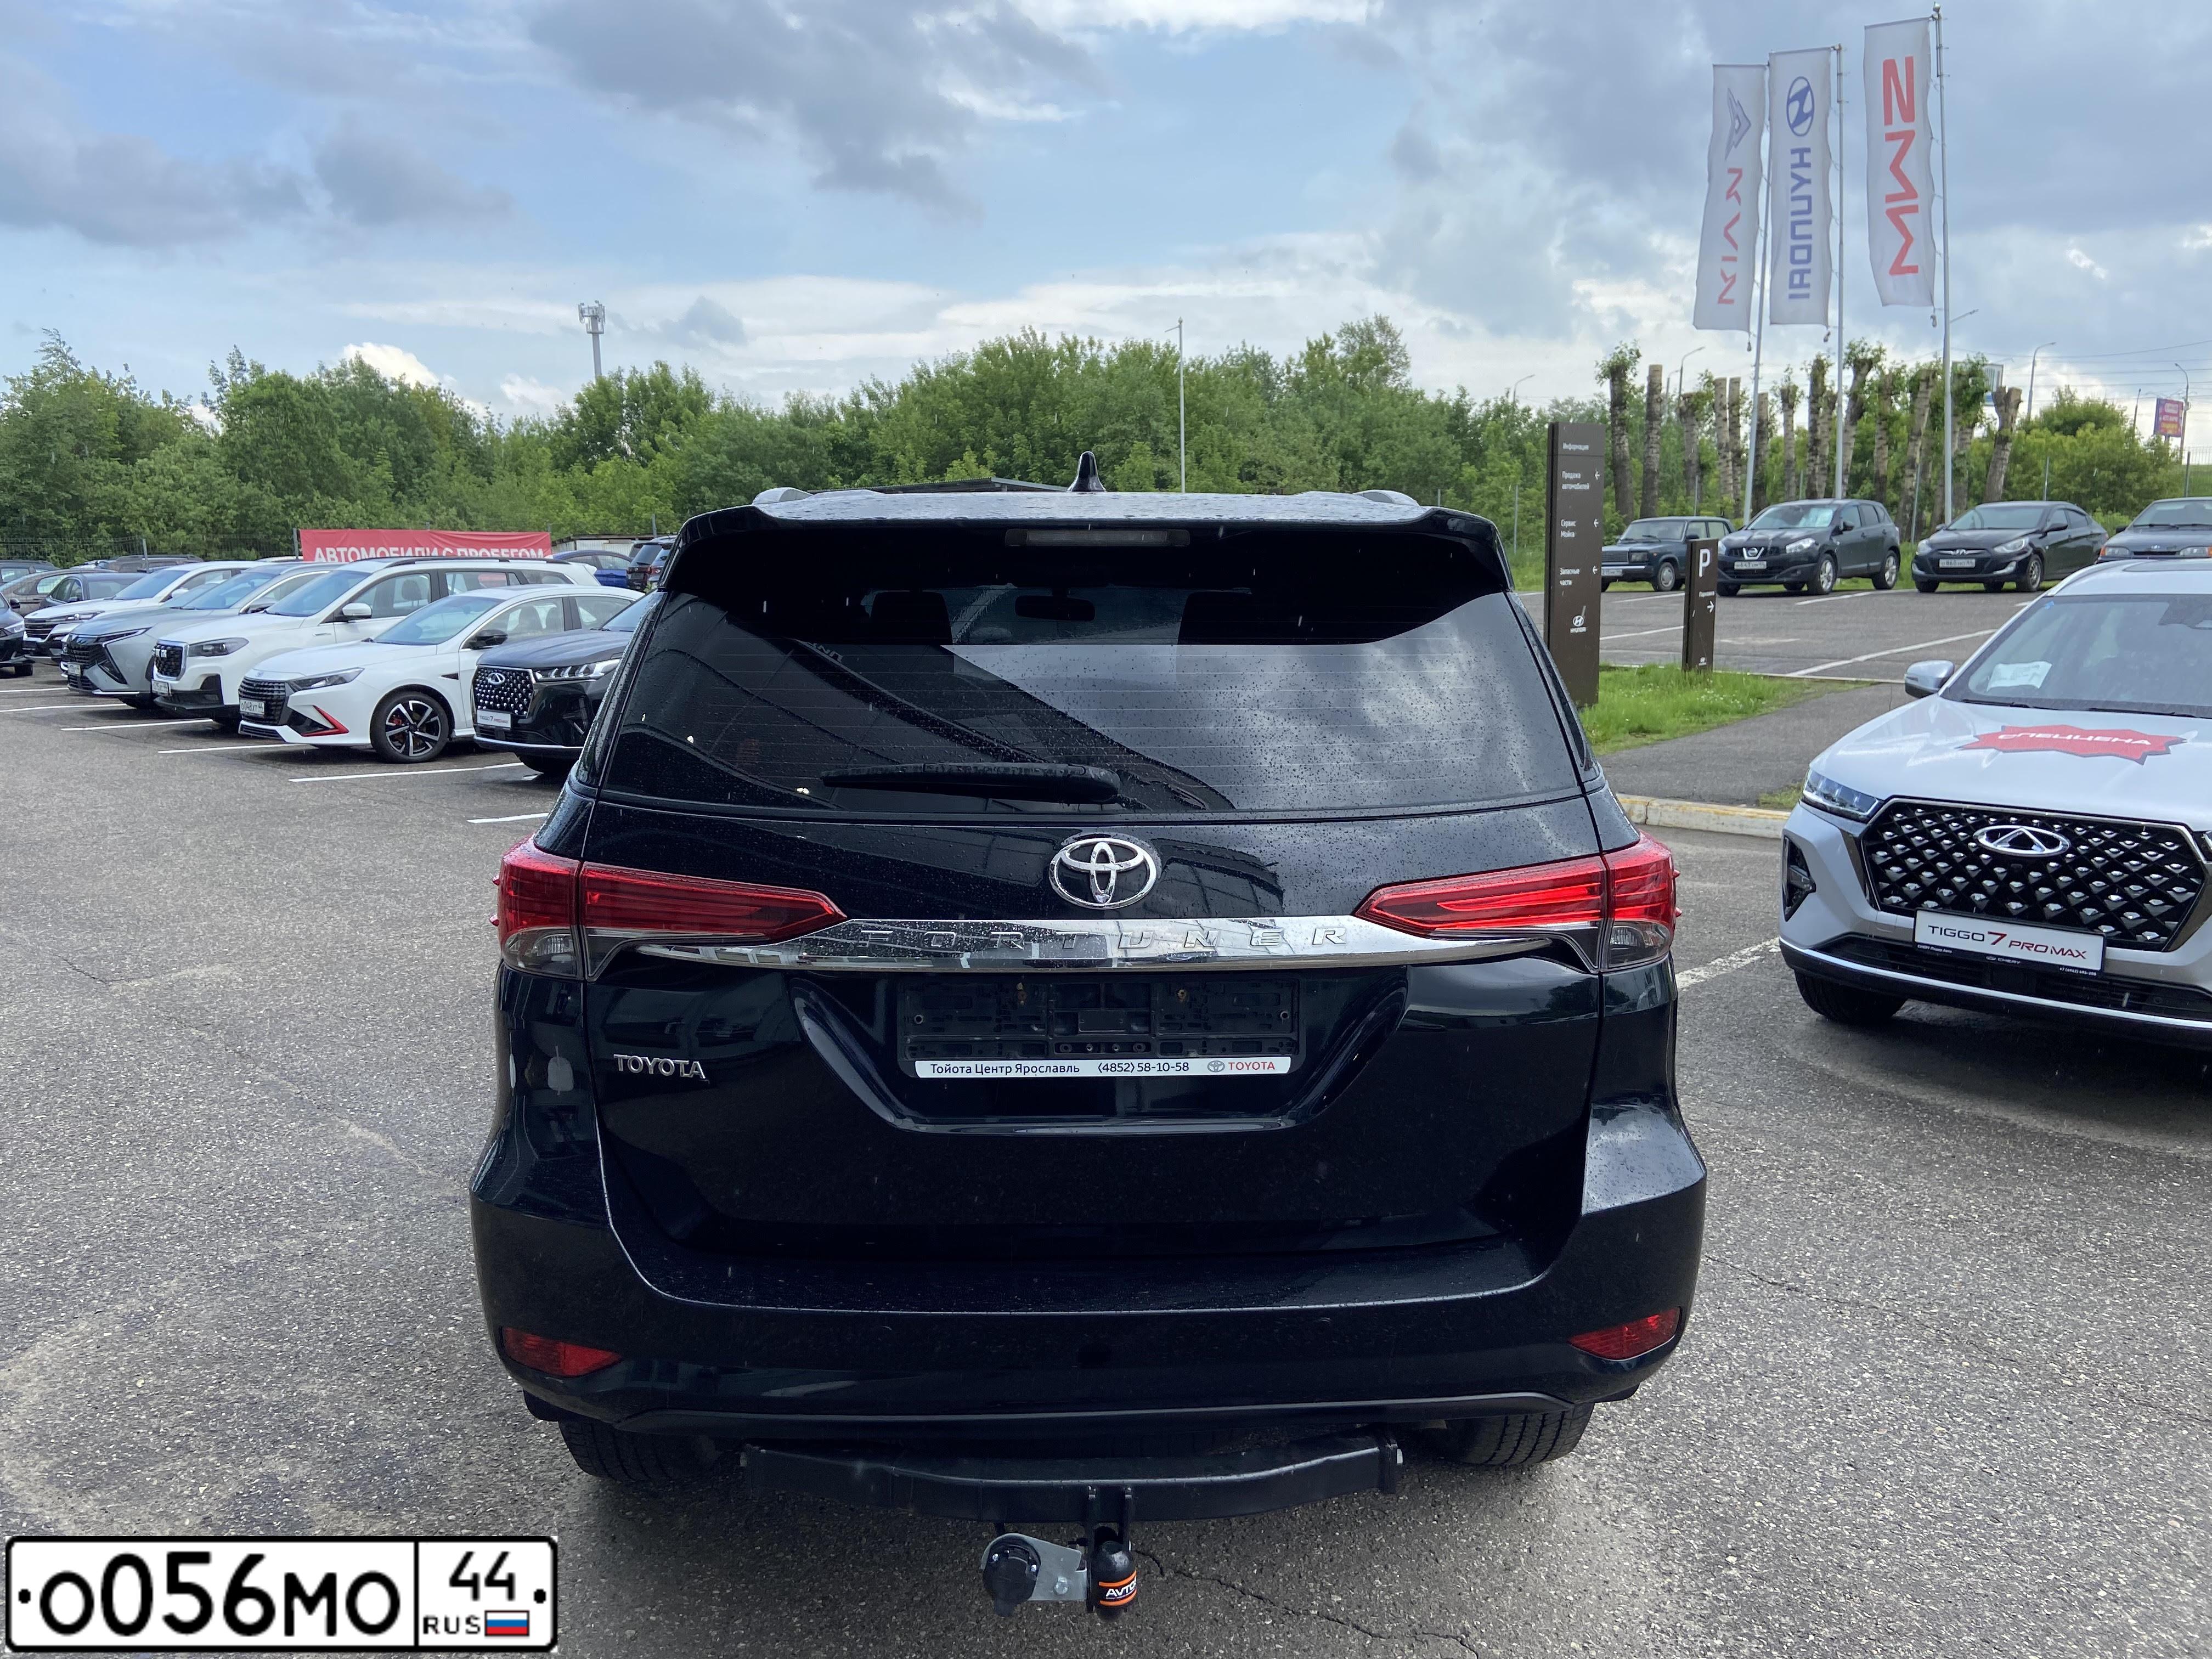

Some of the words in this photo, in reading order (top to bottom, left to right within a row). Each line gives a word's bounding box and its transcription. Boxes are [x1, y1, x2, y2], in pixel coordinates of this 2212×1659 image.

[1562, 471, 1581, 479] Продажа
[1560, 519, 1576, 528] Сервис
[1699, 548, 1711, 577] P
[858, 927, 1347, 949] FORTUNER
[1928, 925, 1985, 942] TIGGO
[1987, 931, 2007, 945] 7
[613, 1053, 706, 1079] TOYOTA
[930, 1063, 972, 1074] Тойота
[975, 1063, 1012, 1076] Центр
[1015, 1063, 1080, 1076] Ярославль
[1098, 1062, 1135, 1074] (4852)
[1137, 1062, 1190, 1072] 58-10-58
[1228, 1061, 1276, 1070] TOYOTA
